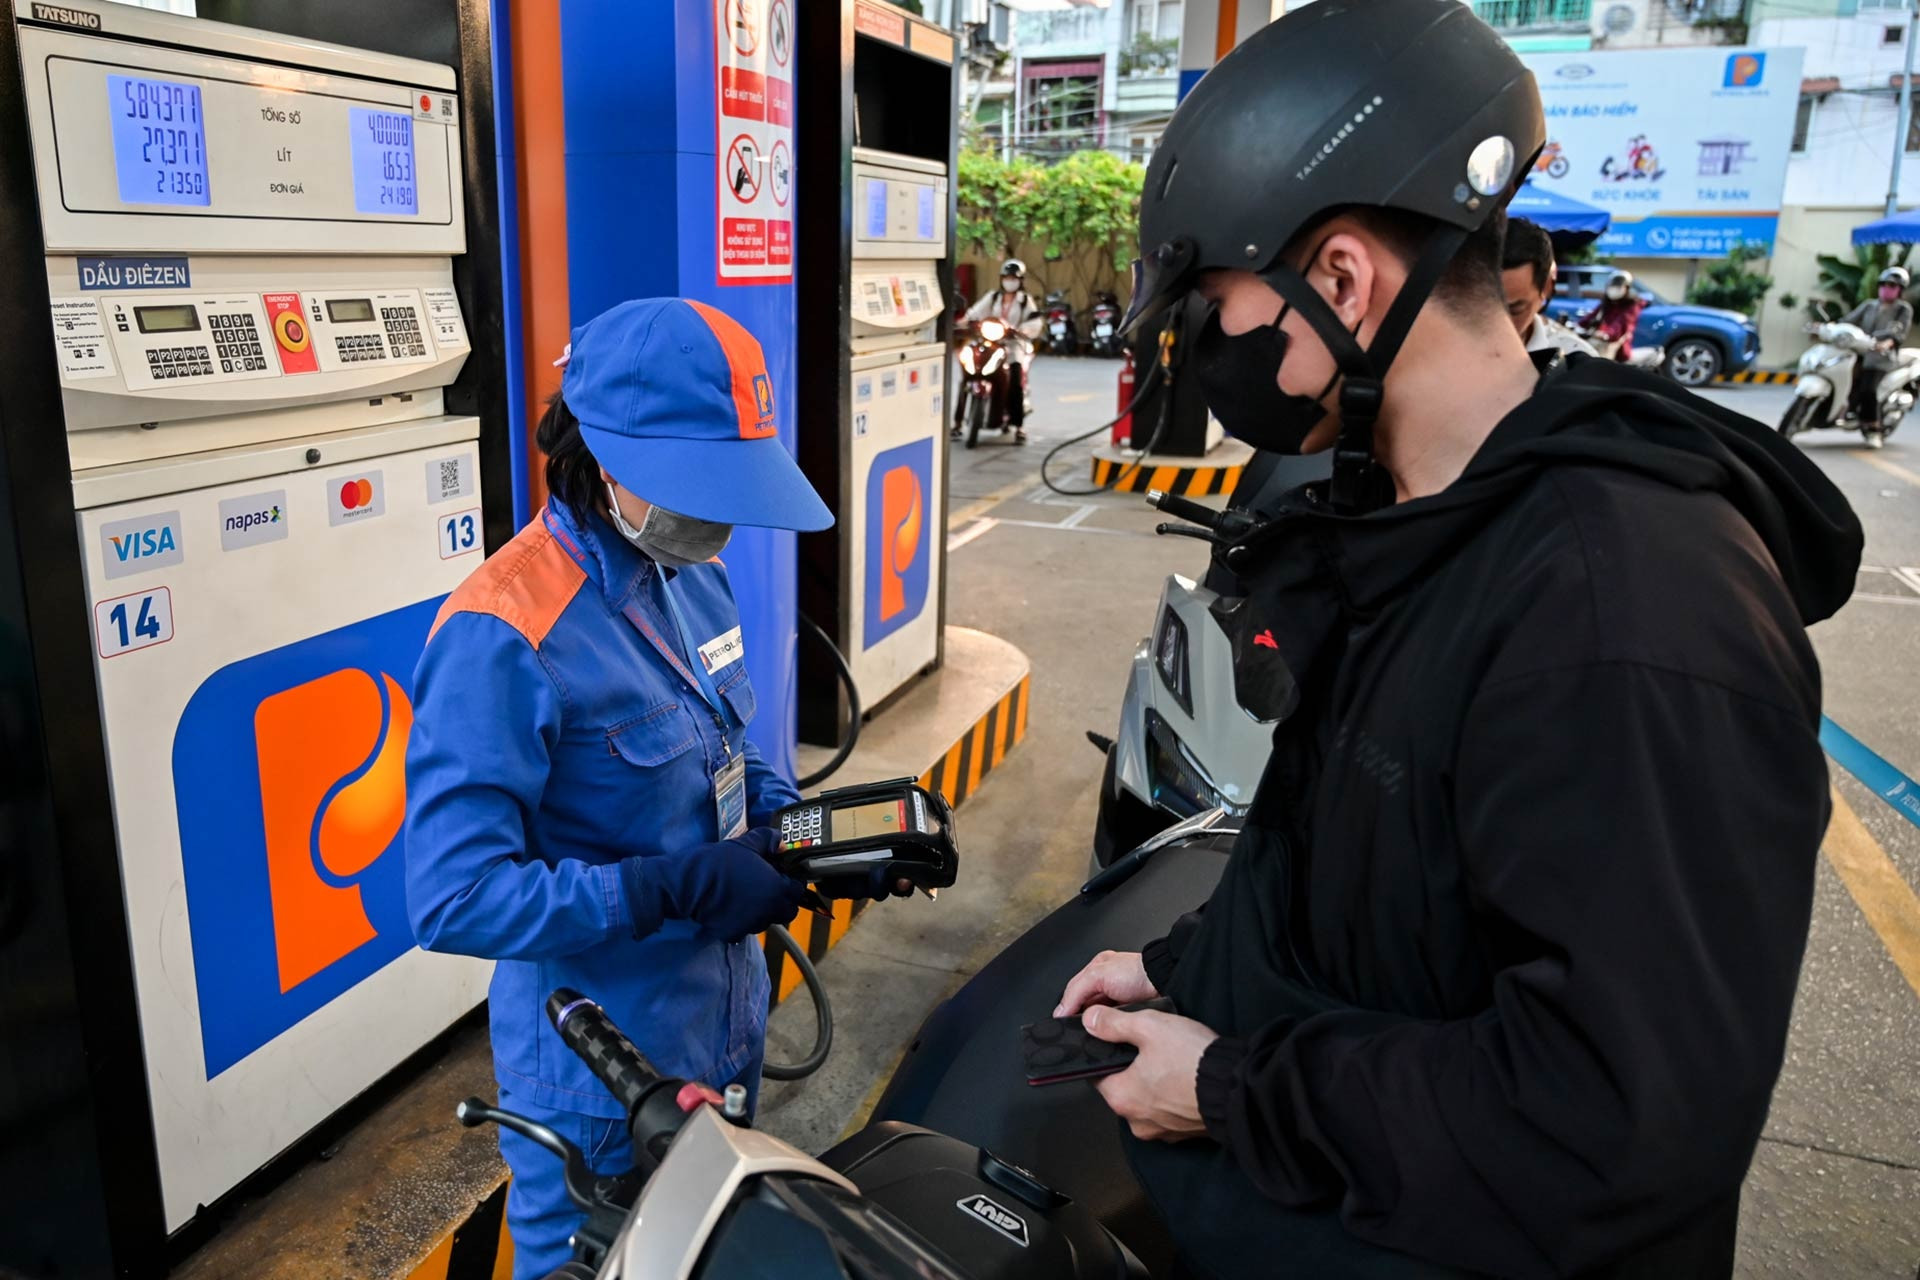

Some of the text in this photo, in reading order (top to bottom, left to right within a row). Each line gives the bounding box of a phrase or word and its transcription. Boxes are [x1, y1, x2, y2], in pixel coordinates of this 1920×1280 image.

[36, 5, 98, 28] TATSUNO
[125, 81, 196, 123] 584371
[261, 107, 301, 125] TỔNG SỐ
[368, 114, 408, 146] 40000
[277, 148, 292, 163] LÍT
[157, 170, 202, 195] 21350
[270, 182, 304, 195] ĐƠN GIÁ
[381, 185, 412, 206] 24190
[83, 261, 186, 286] DẦU ĐIÊZEN
[226, 509, 269, 532] napas
[342, 507, 372, 518] mastercard
[108, 525, 175, 561] VISA
[447, 515, 475, 552] 13
[109, 596, 160, 647] 14
[973, 1199, 1020, 1230] GIVI
